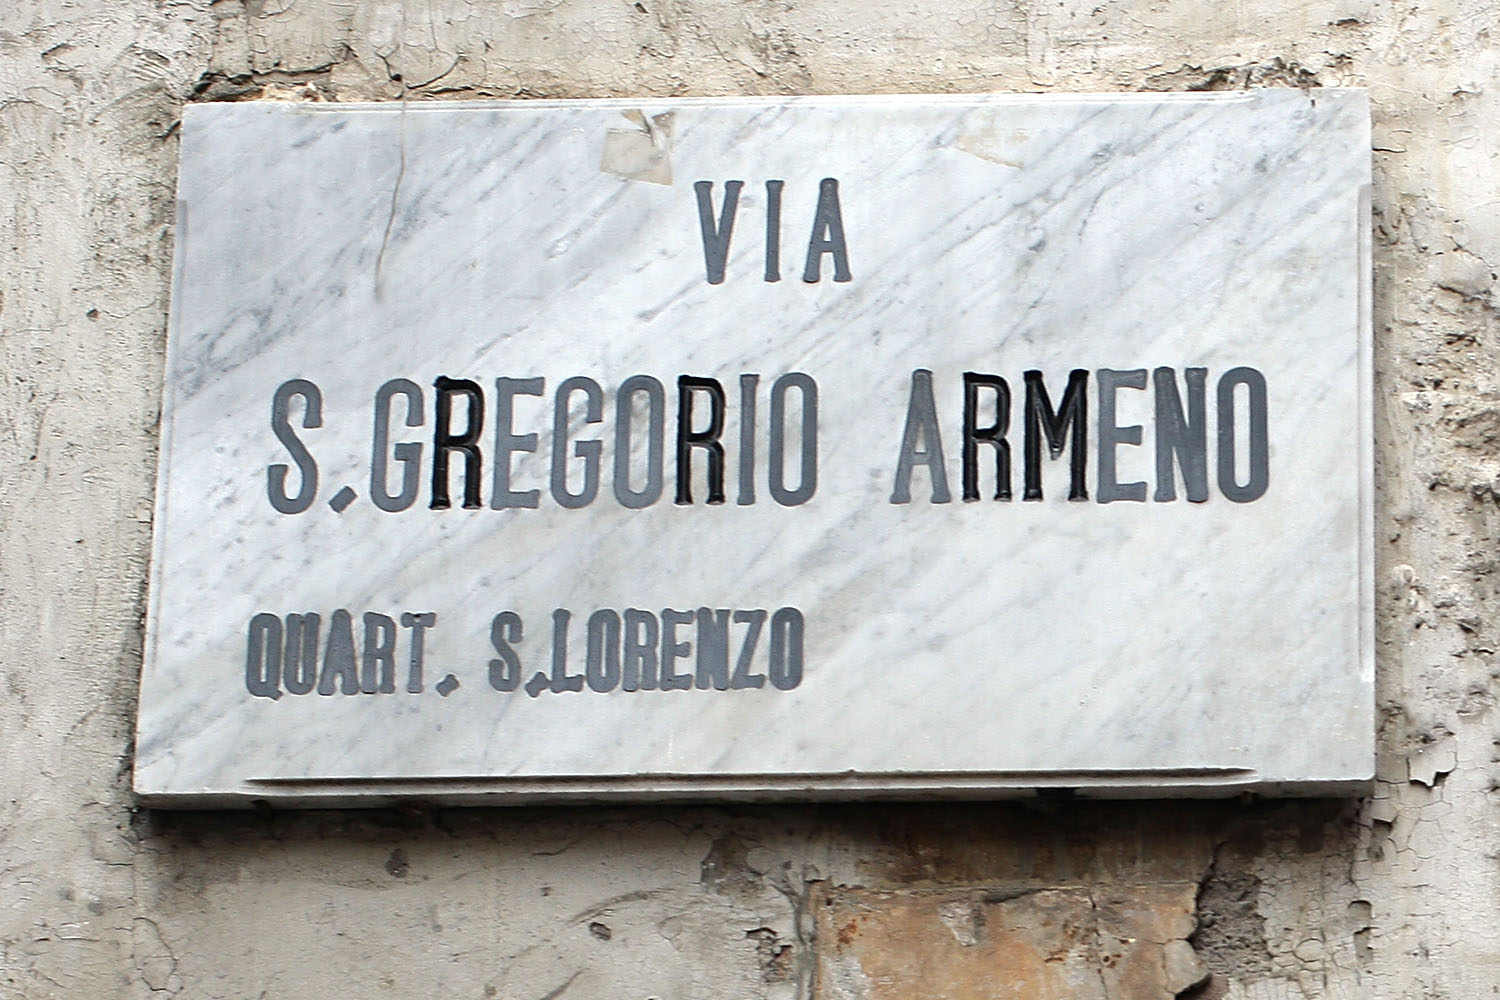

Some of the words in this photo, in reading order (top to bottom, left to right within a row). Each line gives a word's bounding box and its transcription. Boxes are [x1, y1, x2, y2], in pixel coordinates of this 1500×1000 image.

[694, 177, 852, 285] VIA
[890, 366, 1269, 505] ARMENO
[245, 608, 460, 701] QUART.
